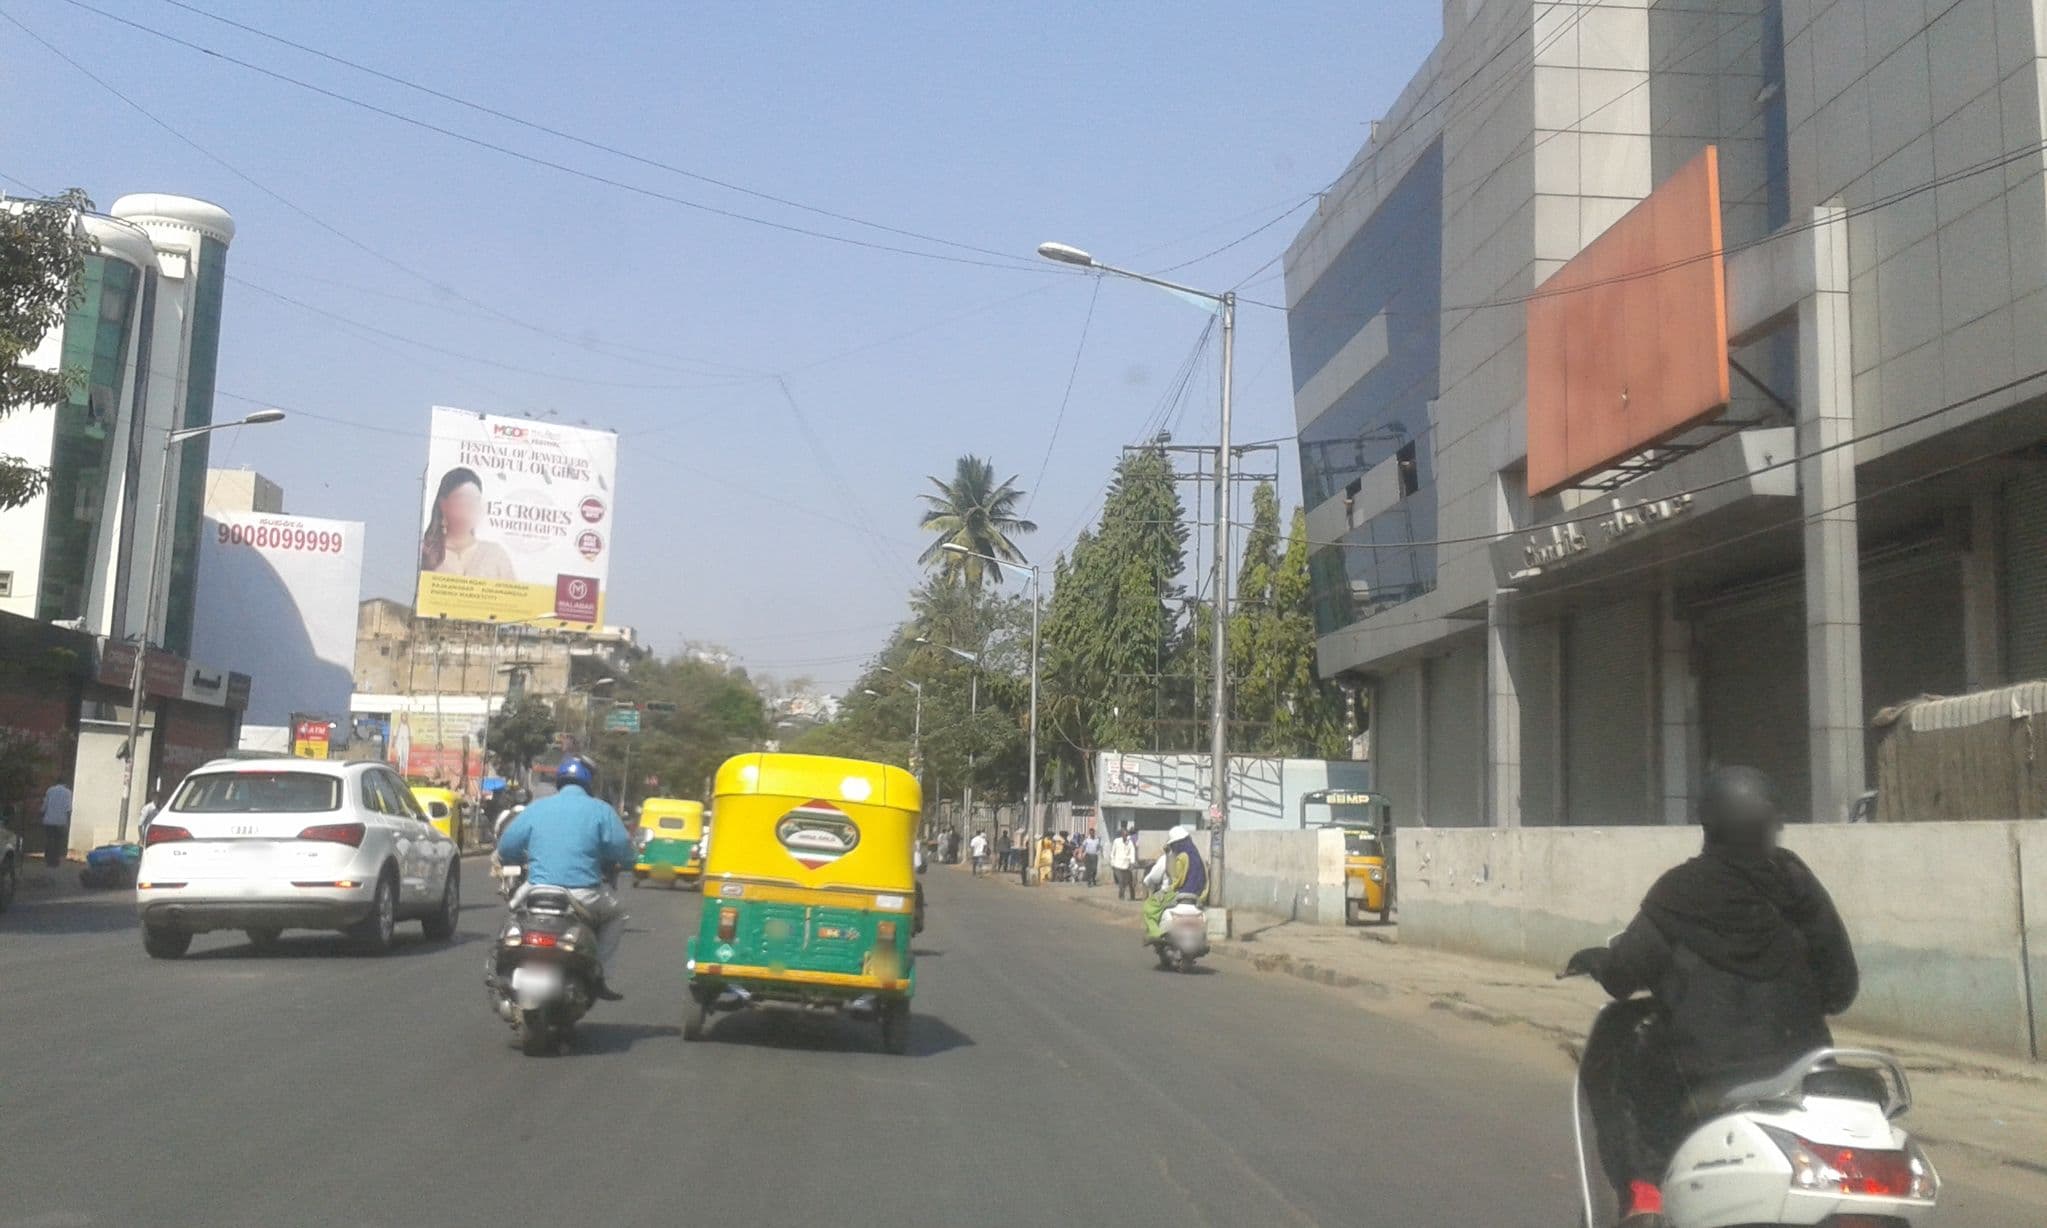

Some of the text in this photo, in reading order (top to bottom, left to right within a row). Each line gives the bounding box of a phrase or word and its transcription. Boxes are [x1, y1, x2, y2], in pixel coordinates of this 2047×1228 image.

[460, 440, 509, 457] FESTIVAL
[512, 448, 528, 458] OF
[459, 452, 528, 473] HANDFUL
[530, 462, 546, 475] OF
[487, 500, 502, 516] 15
[506, 503, 573, 525] CRORES
[217, 522, 343, 553] 9008099999
[489, 517, 532, 533] WORTH
[535, 523, 568, 537] GIFTS
